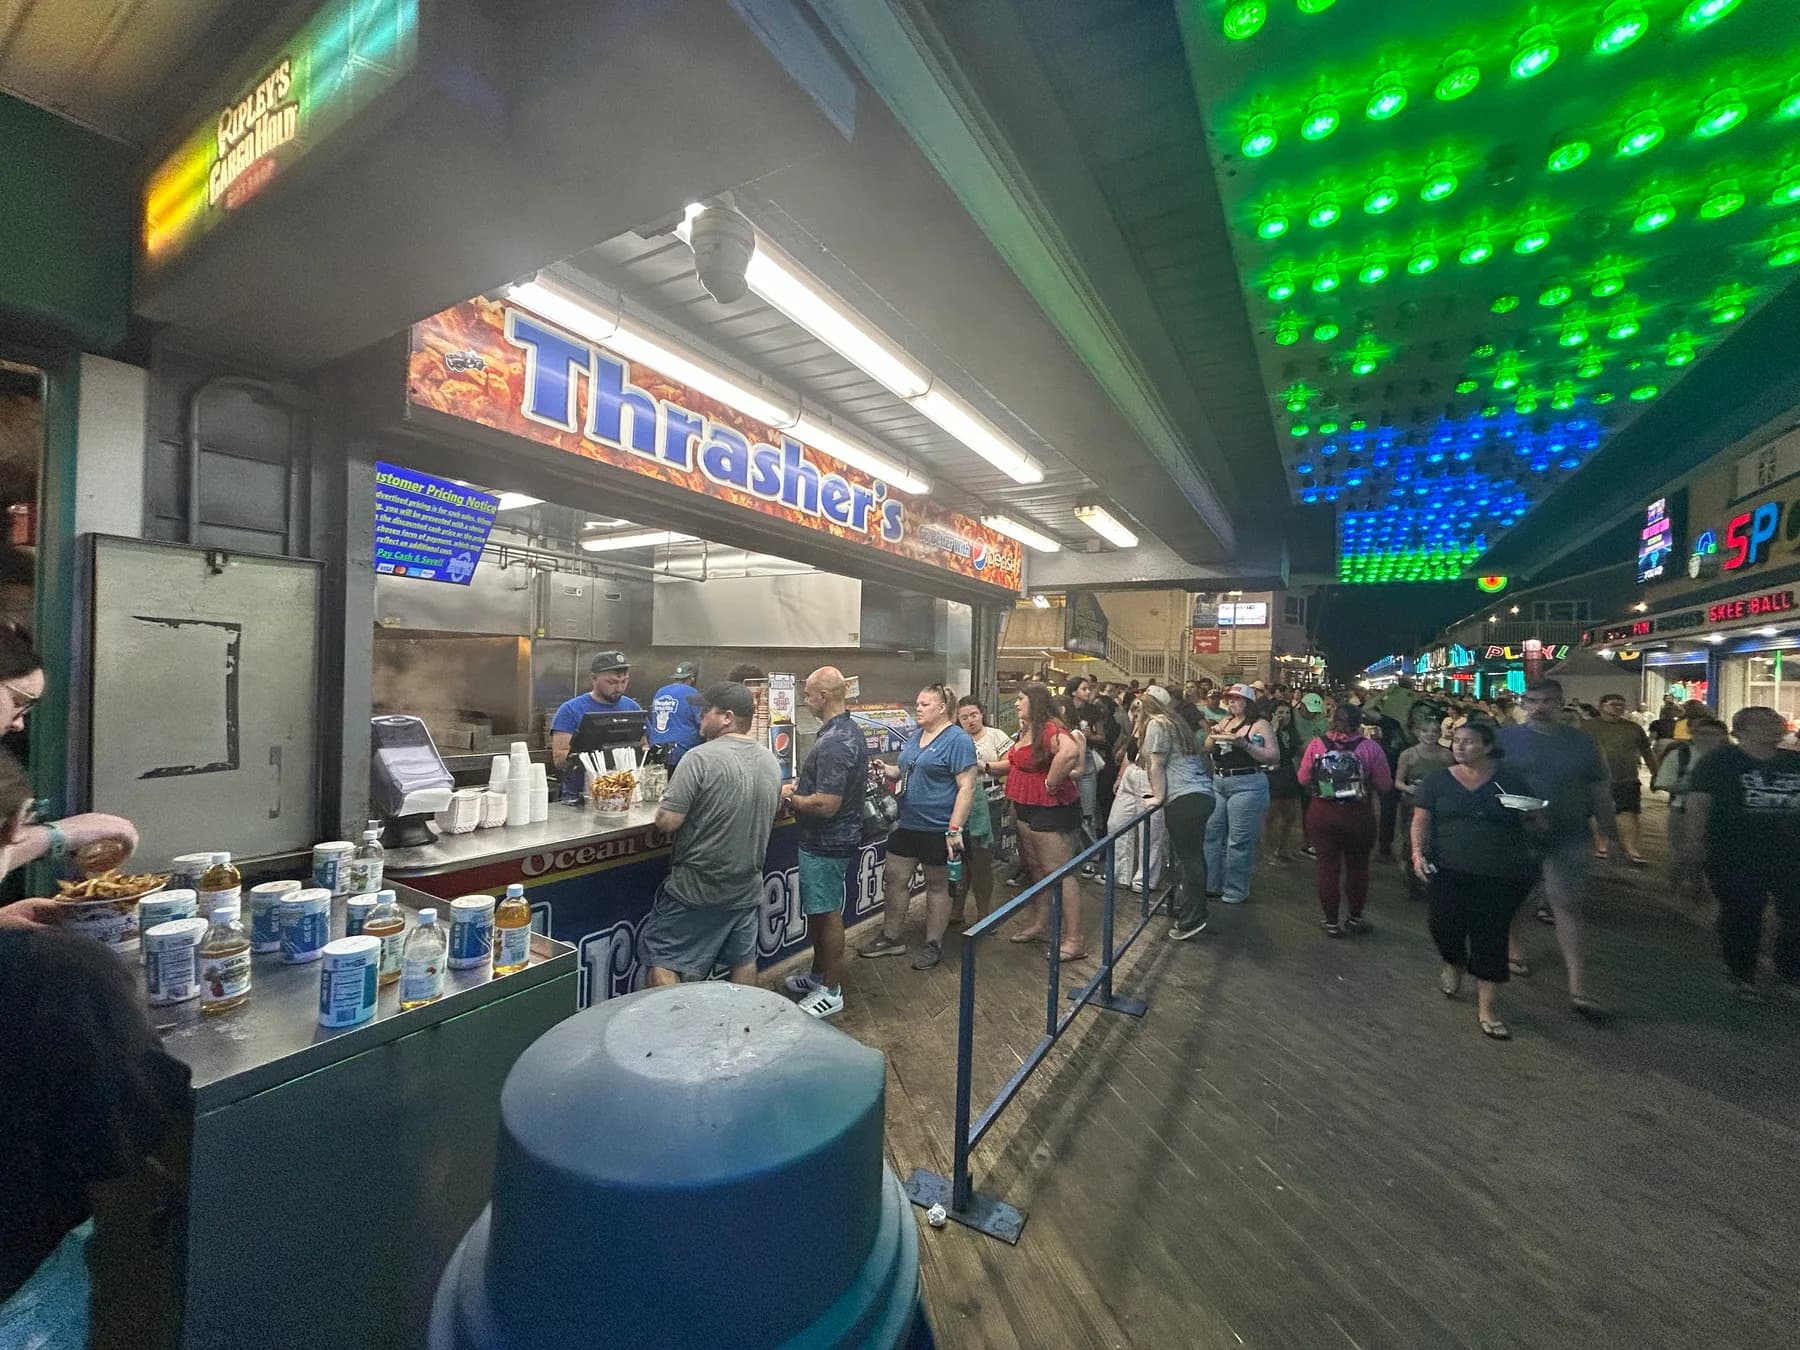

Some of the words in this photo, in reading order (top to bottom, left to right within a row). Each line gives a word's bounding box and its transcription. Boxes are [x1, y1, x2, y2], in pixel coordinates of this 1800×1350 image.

[218, 60, 290, 159] RIPLEY'S
[209, 131, 255, 205] CARGO
[255, 105, 297, 158] HOLD
[504, 307, 904, 543] Thrasher's
[426, 484, 464, 506] Pricing
[466, 495, 496, 513] Notice
[377, 548, 392, 559] Pay
[394, 551, 413, 562] Cash
[1709, 601, 1744, 623] SKEE
[1749, 591, 1791, 614] BALL
[521, 838, 635, 879] Ocean
